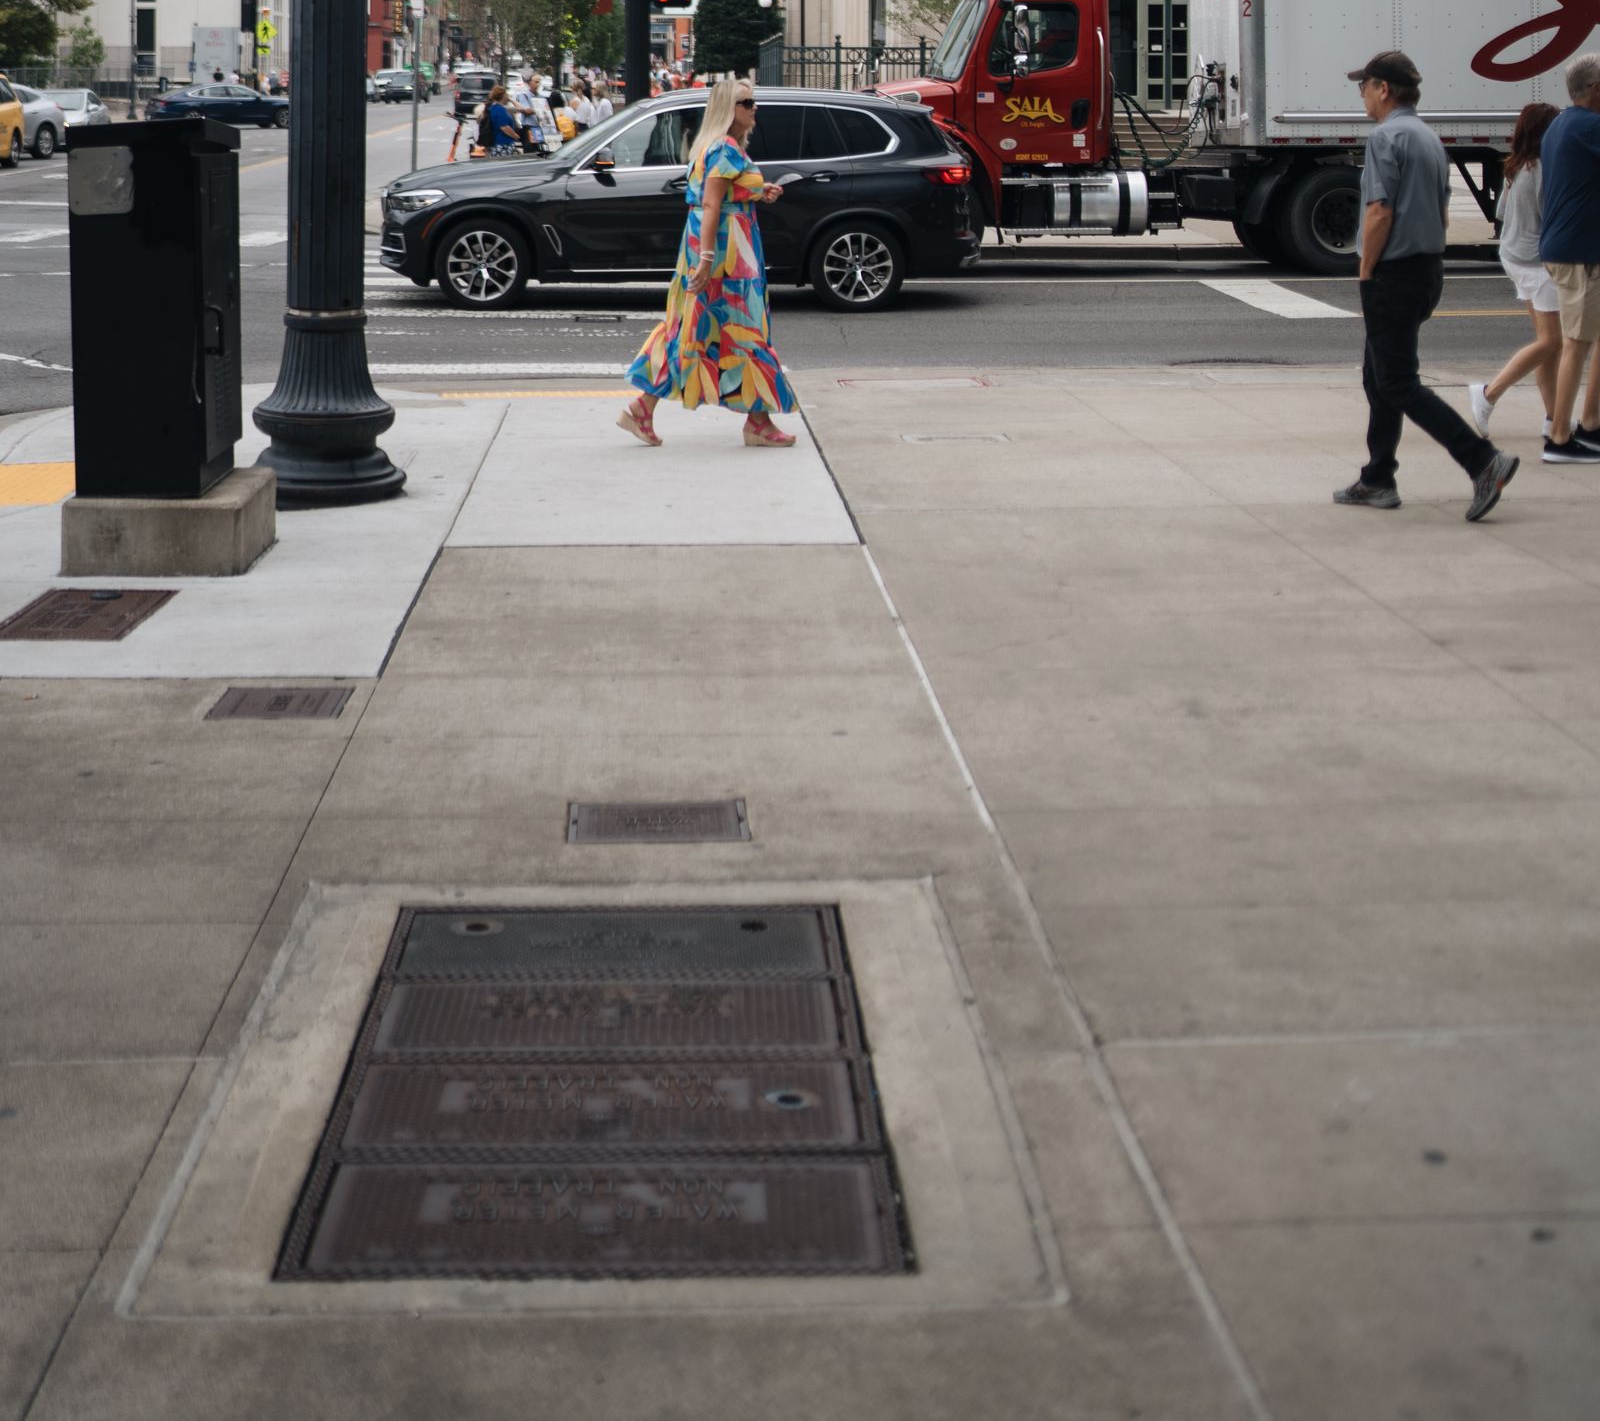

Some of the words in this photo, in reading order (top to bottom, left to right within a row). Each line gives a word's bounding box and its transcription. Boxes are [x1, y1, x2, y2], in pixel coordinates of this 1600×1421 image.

[1002, 96, 1066, 123] SAIA
[655, 1077, 712, 1090] NON
[471, 1096, 582, 1111] METER
[615, 1096, 725, 1110] WATER
[463, 1178, 621, 1195] TRAFFIC
[658, 1180, 723, 1194] NON
[453, 1203, 579, 1221] METER
[616, 1203, 739, 1220] WATER
